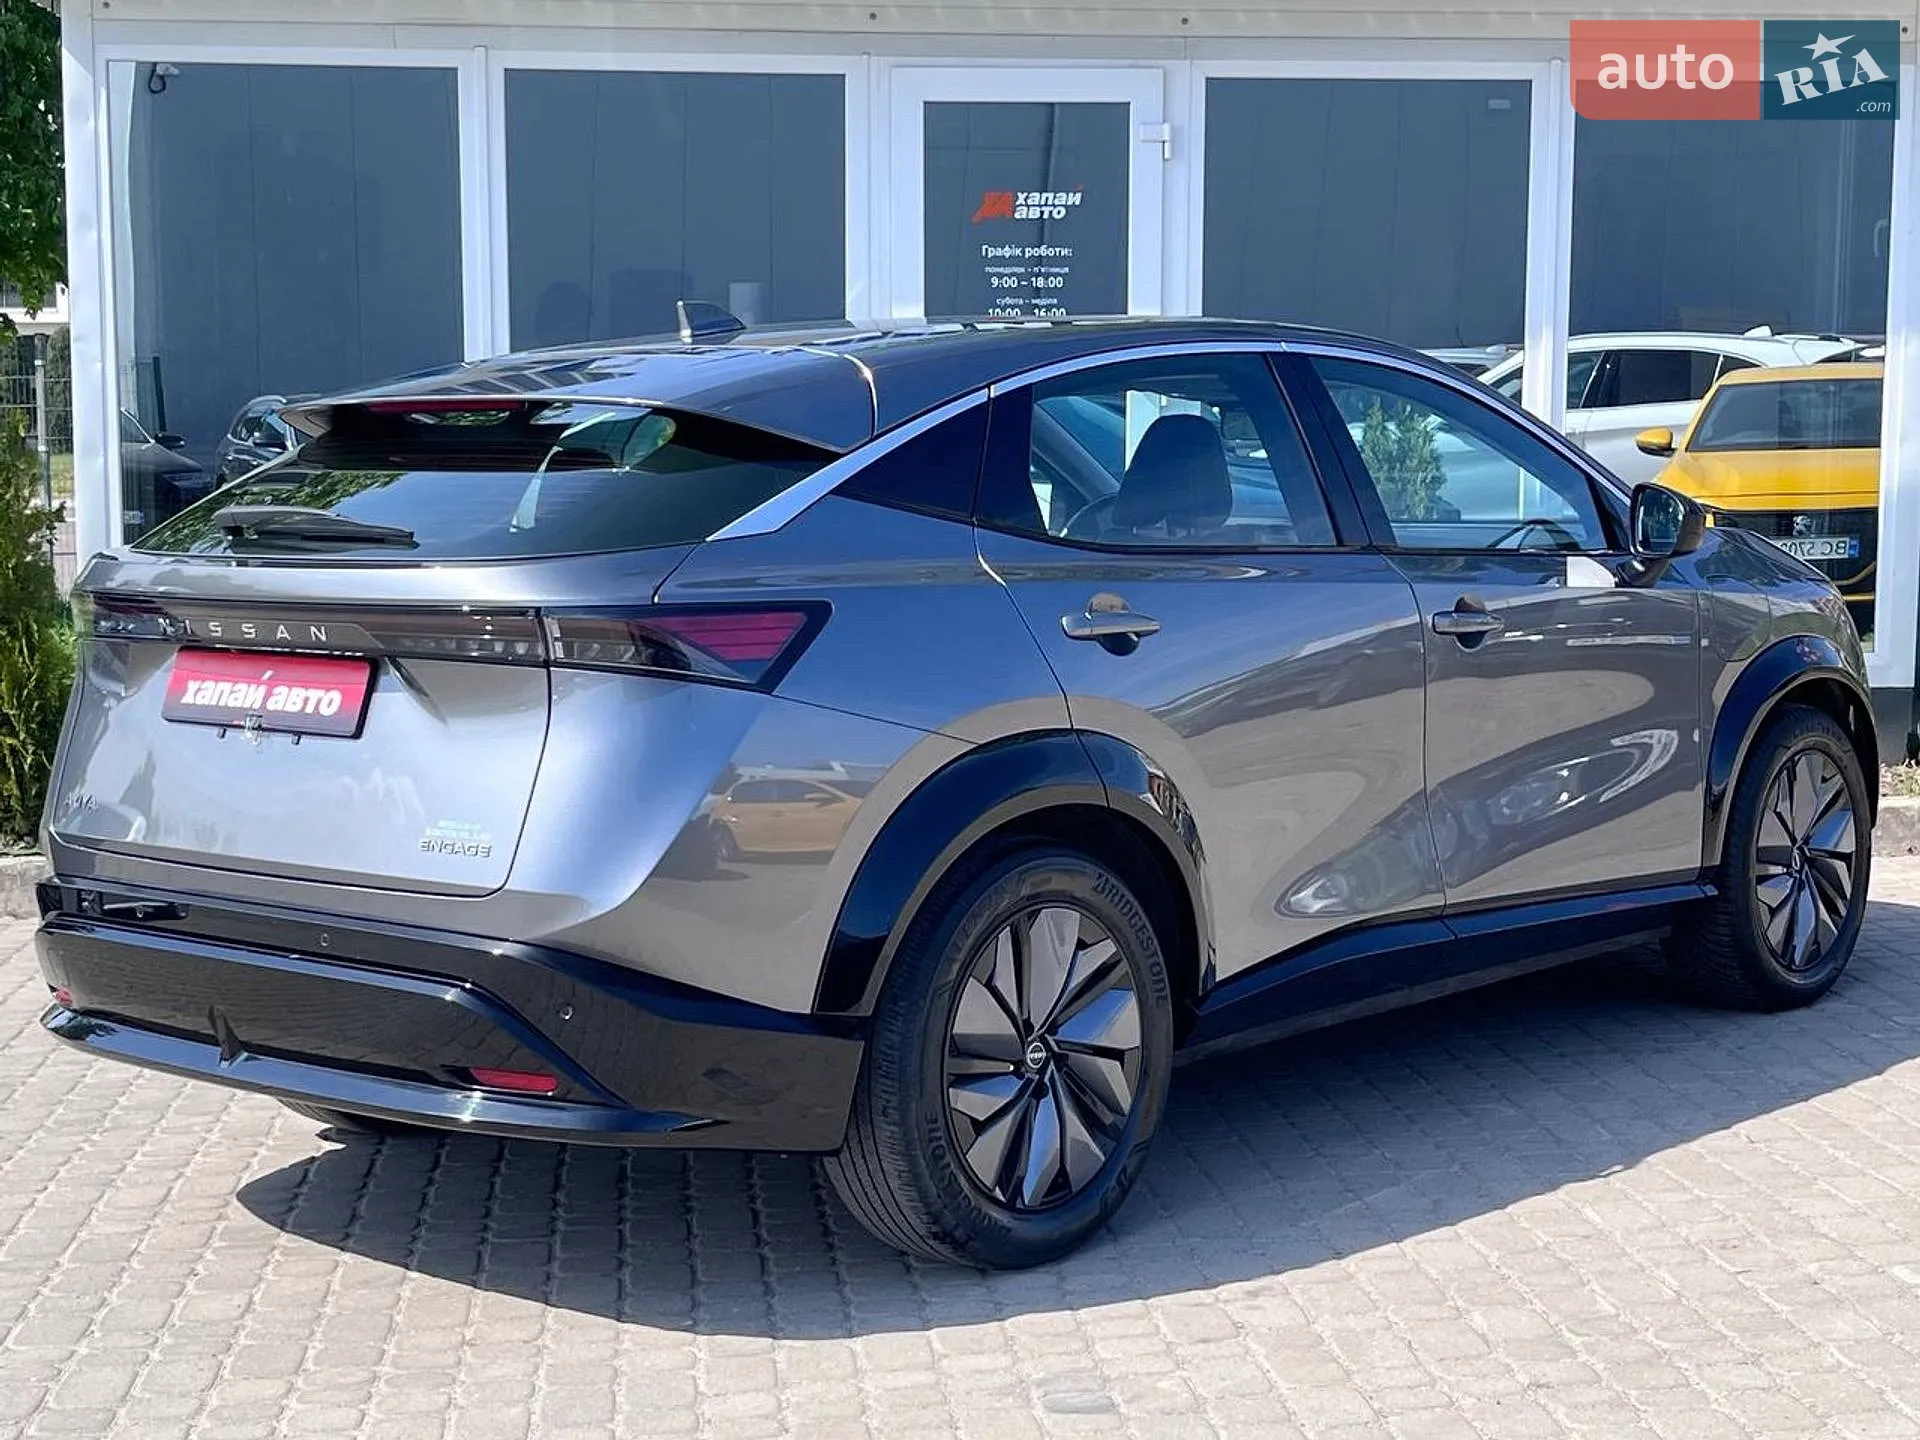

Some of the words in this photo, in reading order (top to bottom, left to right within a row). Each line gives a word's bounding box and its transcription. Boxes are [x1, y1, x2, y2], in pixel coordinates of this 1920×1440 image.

[1015, 186, 1084, 206] хапай
[1014, 205, 1066, 219] авто
[981, 244, 1022, 258] Графік
[1024, 244, 1073, 258] роботи:
[990, 277, 1018, 288] 9:00
[1030, 277, 1064, 288] 18:00
[158, 618, 328, 642] NISSAN
[180, 671, 270, 706] хапай
[265, 683, 343, 717] авто
[419, 839, 493, 858] ENGAGE
[1092, 871, 1169, 1007] BRIDGESTONE
